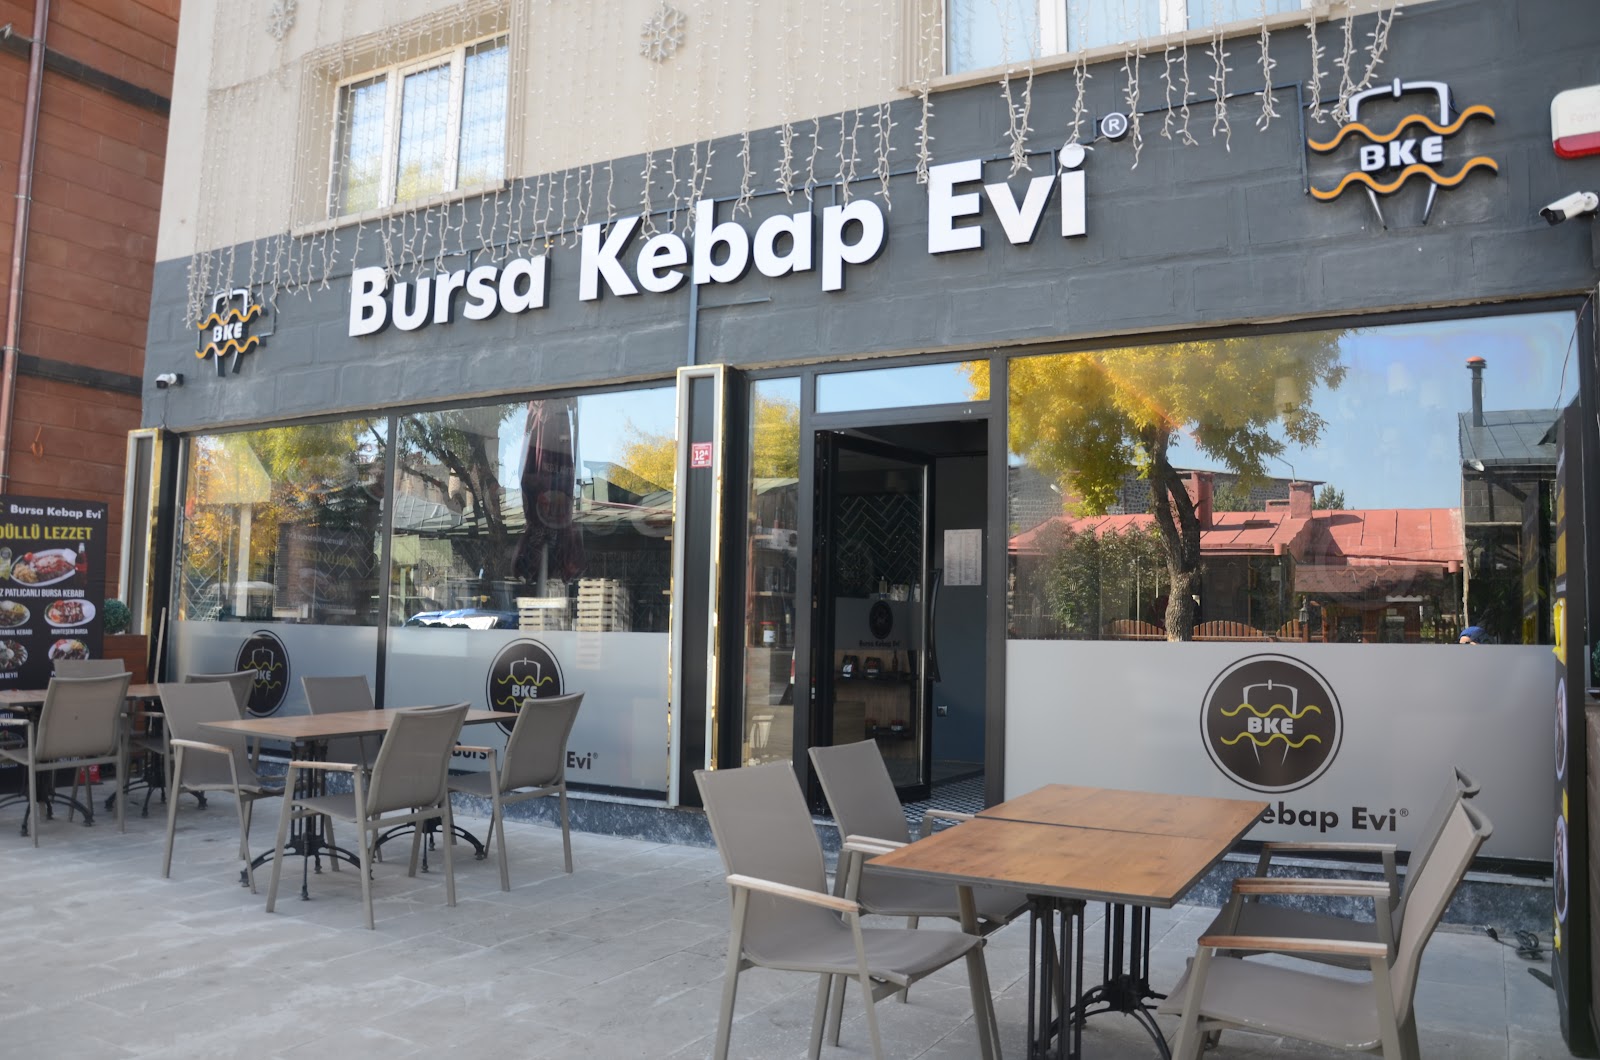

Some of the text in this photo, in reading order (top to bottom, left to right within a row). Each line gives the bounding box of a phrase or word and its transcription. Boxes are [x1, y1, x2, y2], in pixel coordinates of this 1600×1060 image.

[1360, 136, 1443, 171] BKE
[349, 255, 547, 336] Bursa
[579, 199, 884, 300] Kebap
[213, 322, 243, 342] BKE
[10, 504, 44, 516] Bursa
[47, 506, 83, 519] Kebap
[44, 526, 93, 540] LEZZET
[5, 588, 41, 598] PATLICANLI
[41, 589, 62, 598] BURSA
[63, 590, 85, 598] KEBABI
[511, 684, 538, 698] BKE
[1247, 716, 1293, 735] BKE
